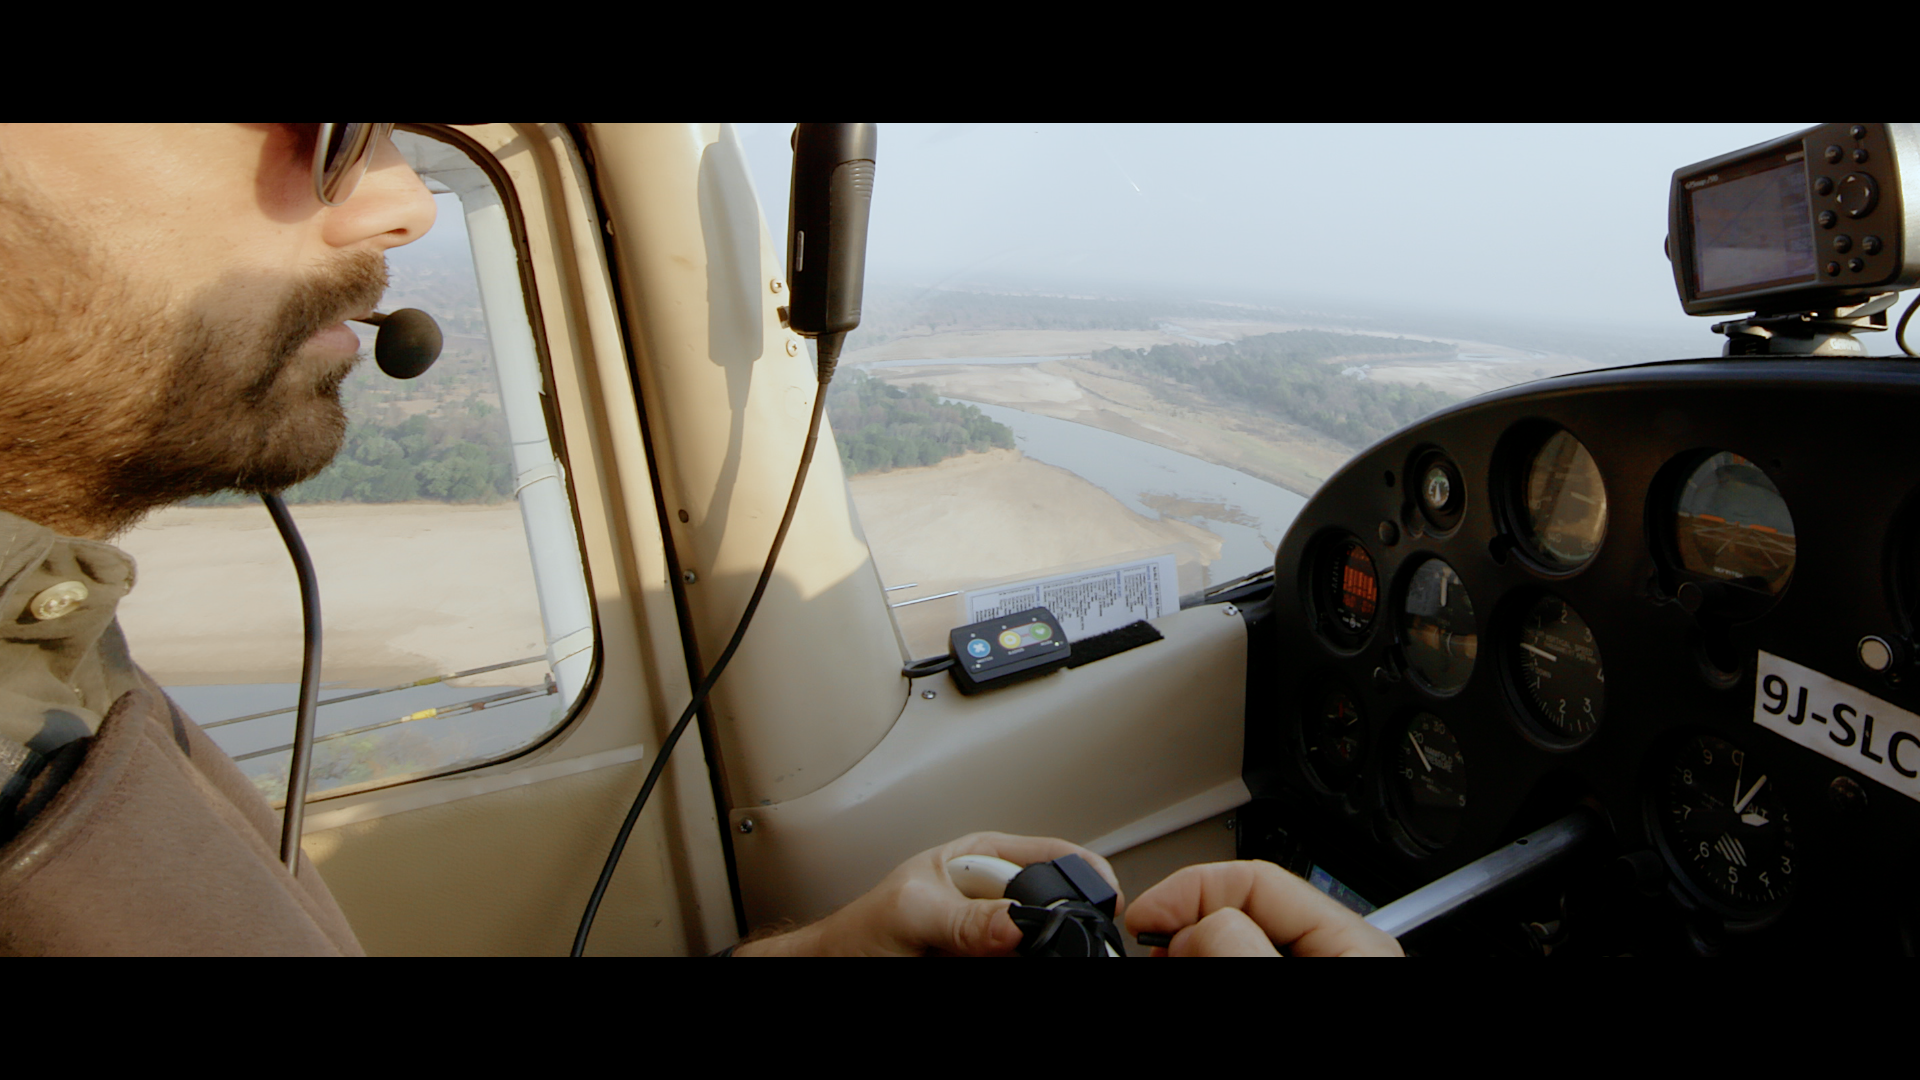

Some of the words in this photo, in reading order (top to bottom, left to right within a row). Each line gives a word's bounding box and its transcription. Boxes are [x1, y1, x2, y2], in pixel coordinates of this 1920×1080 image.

[1559, 699, 1567, 714] 2
[1583, 698, 1592, 714] 3
[1762, 674, 1920, 778] 9J-SLC
[1702, 748, 1713, 765] 9
[1682, 768, 1693, 785] 8
[1682, 803, 1692, 820] 7
[1699, 840, 1710, 858] 6
[1780, 854, 1792, 875] 3
[1728, 866, 1739, 884] 5
[1758, 871, 1770, 888] 4
